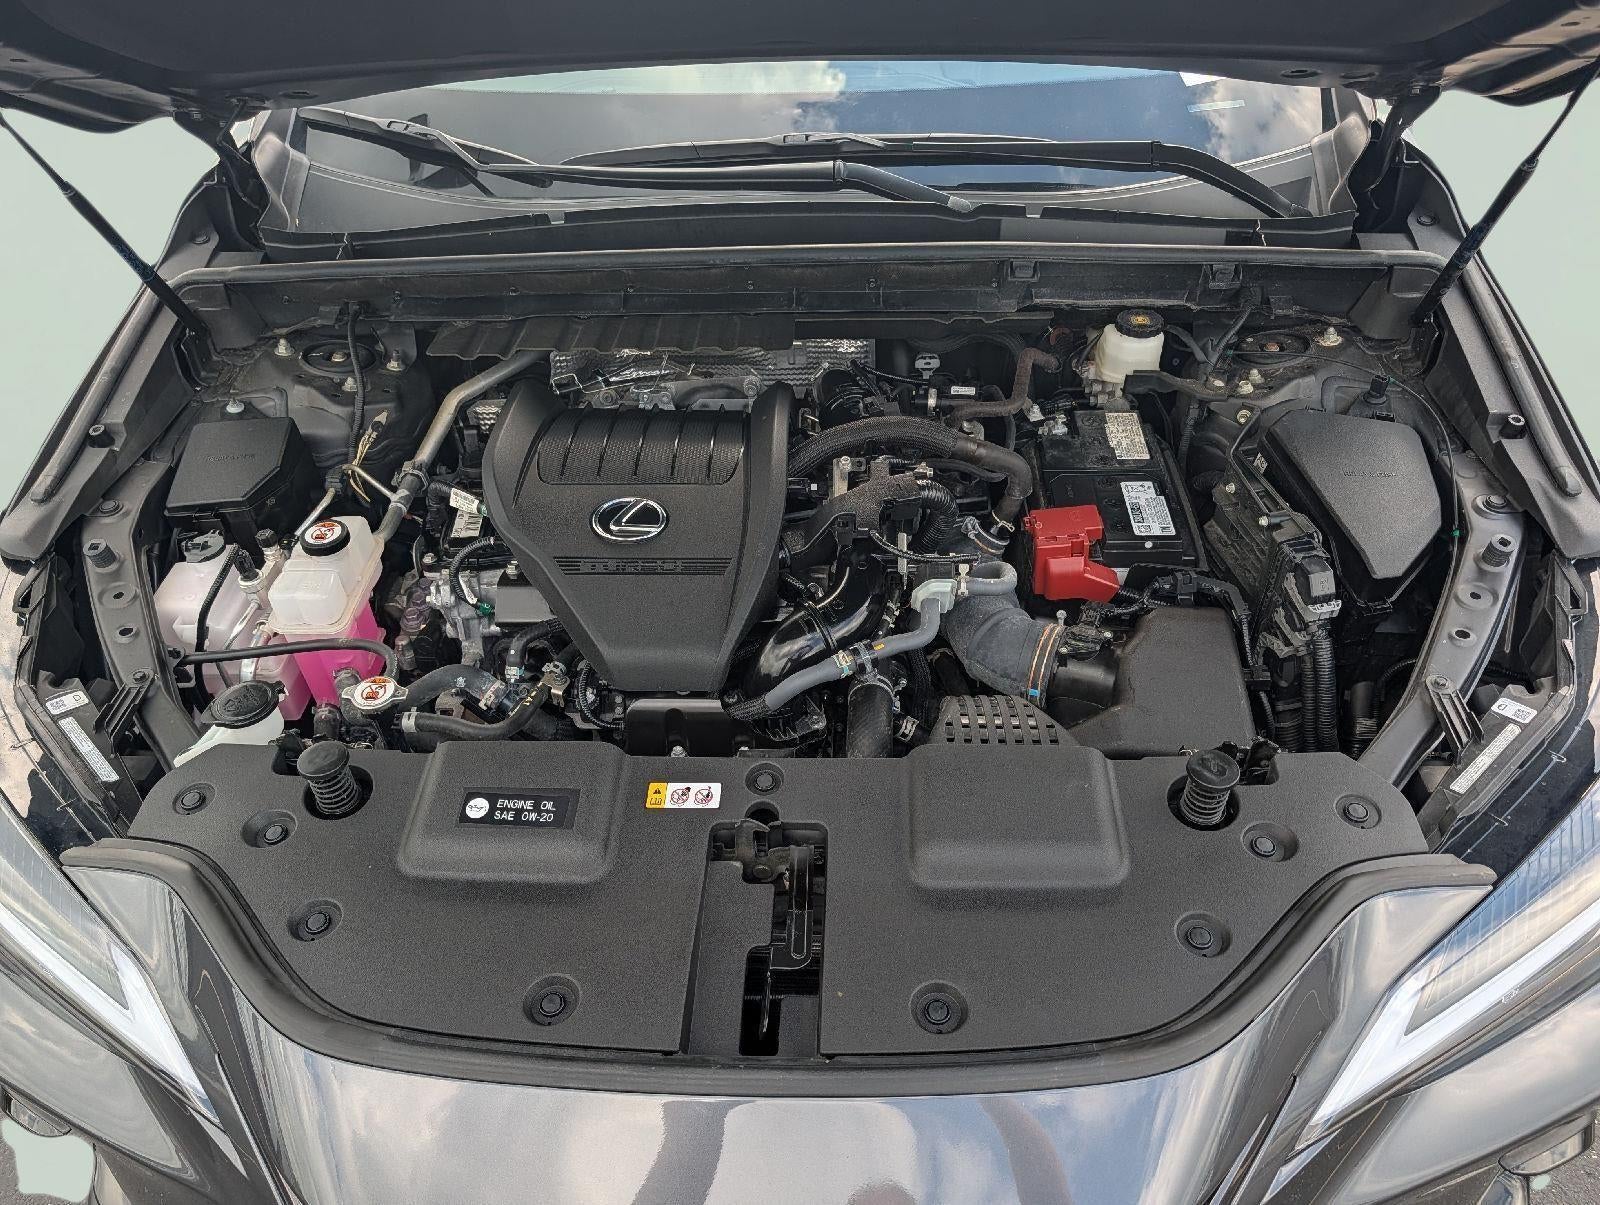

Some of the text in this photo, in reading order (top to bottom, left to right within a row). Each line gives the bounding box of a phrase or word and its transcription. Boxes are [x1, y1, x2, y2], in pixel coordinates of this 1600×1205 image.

[496, 799, 556, 810] ENGINE OIL
[493, 810, 554, 822] SAE 0W-20
